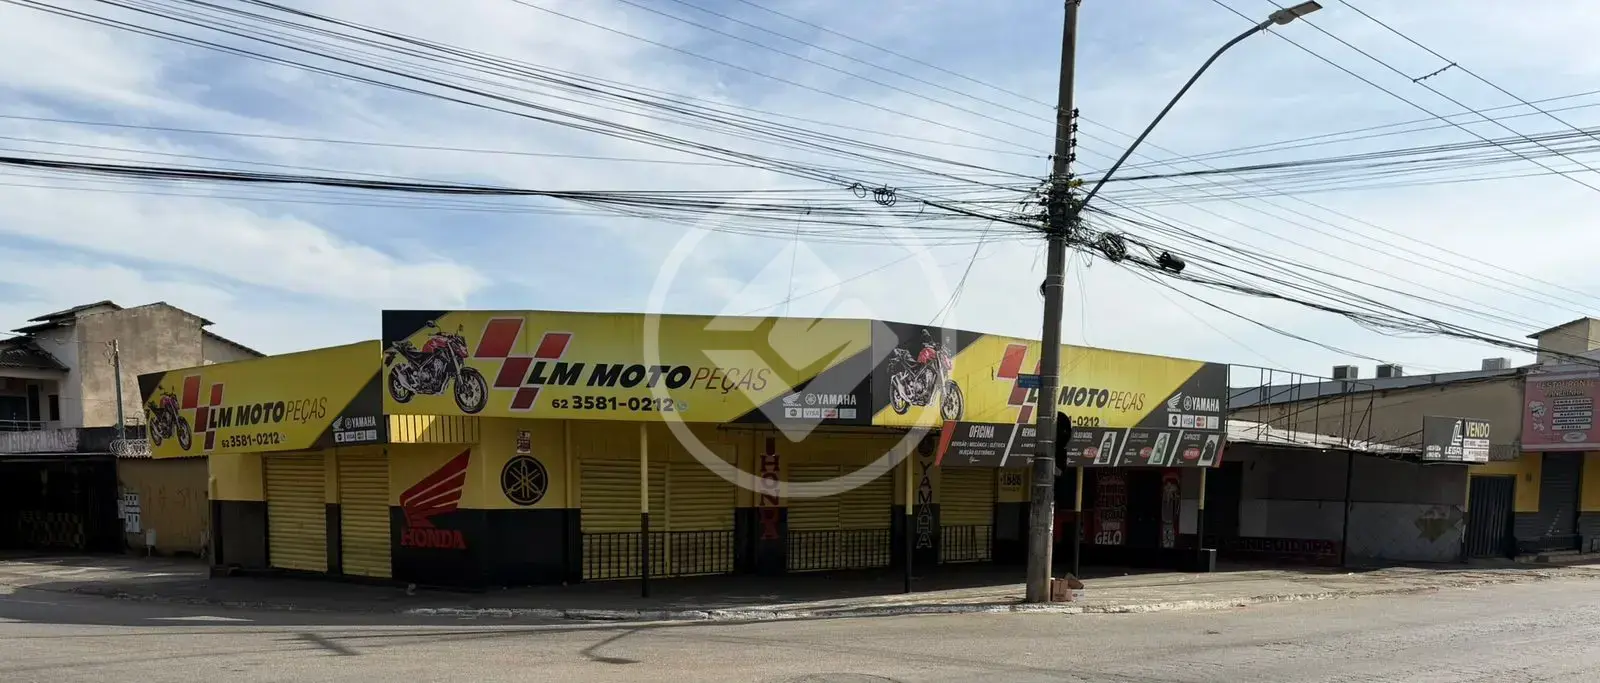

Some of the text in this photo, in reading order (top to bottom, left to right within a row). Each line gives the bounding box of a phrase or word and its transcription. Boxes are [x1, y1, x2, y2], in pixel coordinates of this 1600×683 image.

[527, 362, 771, 394] LM MOTO PEÇAS
[552, 395, 674, 411] 62 3581-0212
[817, 394, 857, 405] YAMAHA
[1058, 386, 1109, 408] MOTO
[1107, 391, 1146, 413] PEÇAS
[1192, 396, 1220, 412] YAMAHA
[209, 396, 327, 429] LM MOTO PEÇAS
[351, 416, 377, 428] YAMAHA
[1465, 421, 1490, 438] VENDO
[969, 425, 995, 438] OFICINA
[221, 432, 280, 448] 62 3581-0212
[760, 454, 780, 540] HONDA
[915, 461, 932, 549] YAMAHA
[400, 528, 467, 549] HONDA
[1094, 530, 1121, 545] GELO
